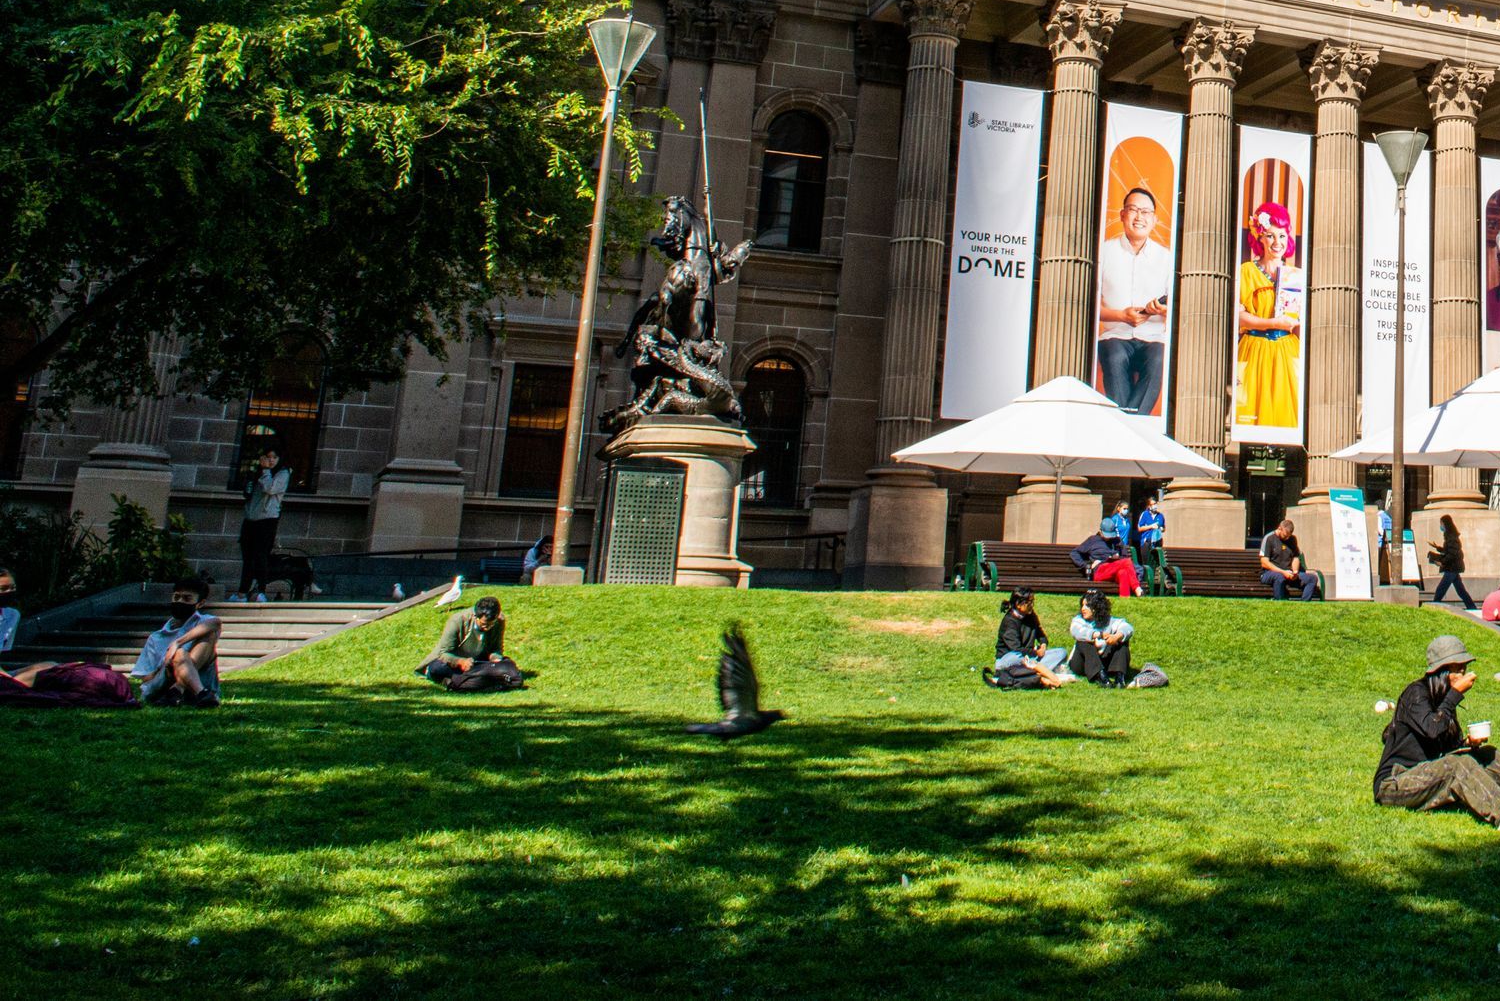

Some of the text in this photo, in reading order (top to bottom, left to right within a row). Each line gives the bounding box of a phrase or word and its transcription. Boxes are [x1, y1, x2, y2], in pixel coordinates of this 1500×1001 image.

[986, 124, 1016, 133] VICTORIA
[991, 119, 1035, 130] STATE LIBRARY
[960, 230, 1028, 245] YOUR HOME
[971, 245, 1015, 256] UNDER THE
[957, 255, 1026, 279] DOME
[1370, 288, 1421, 301] INCREIBLE
[1365, 300, 1427, 314] COLLECIONS
[1377, 332, 1413, 343] EXPETS
